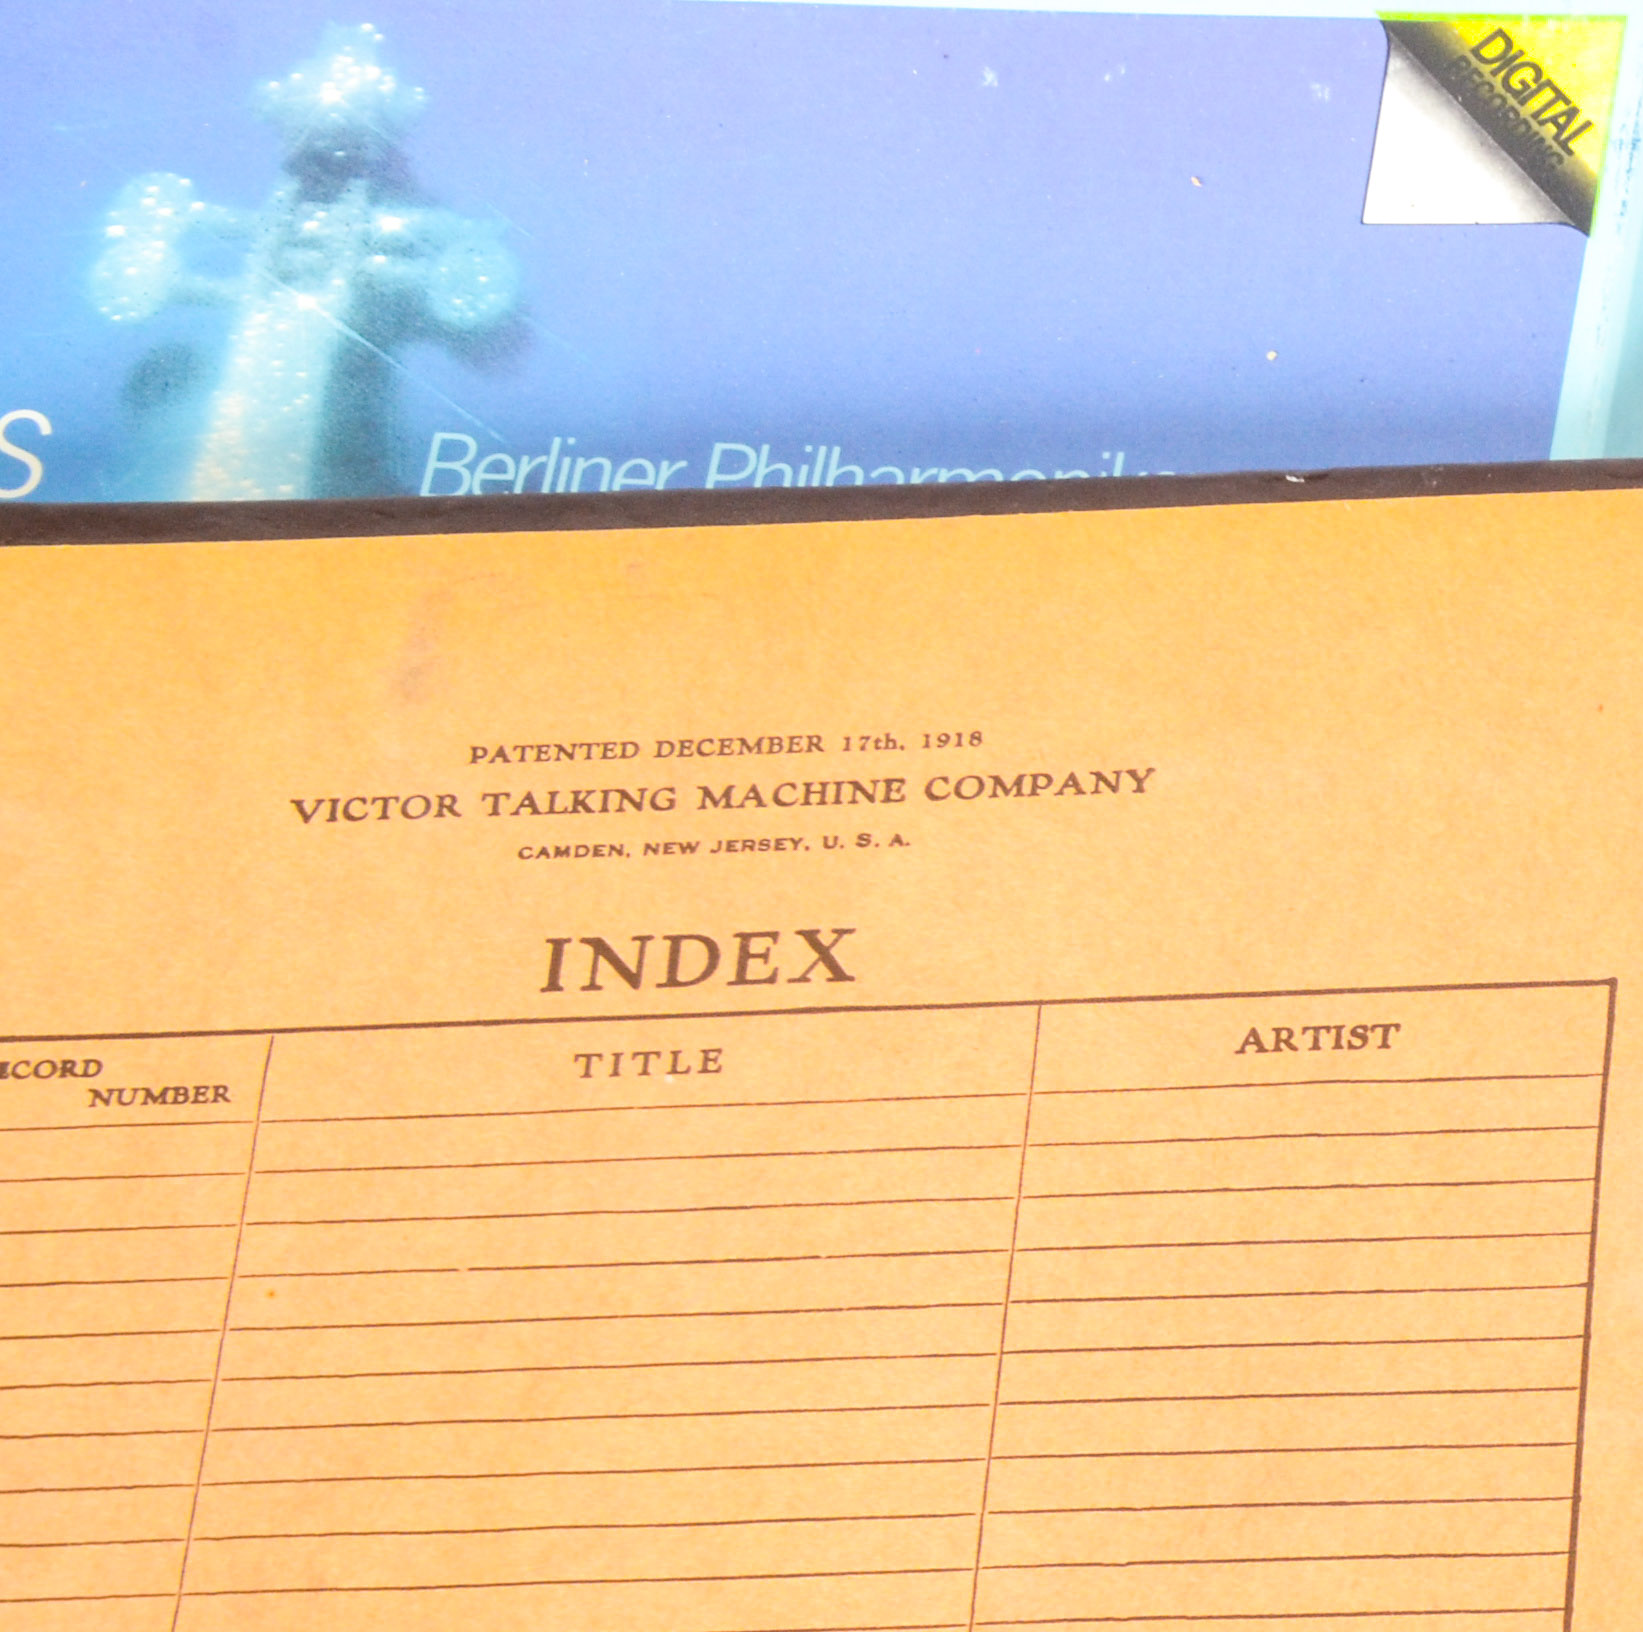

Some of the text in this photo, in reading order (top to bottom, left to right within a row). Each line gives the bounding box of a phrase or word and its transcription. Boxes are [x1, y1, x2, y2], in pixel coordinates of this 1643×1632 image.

[1449, 54, 1565, 171] RECORDING
[1469, 28, 1594, 157] DIGITAL
[420, 433, 688, 496] Berliner
[469, 739, 640, 766] PATENTED
[653, 734, 826, 760] DECEMBER
[921, 730, 983, 750] 1918
[290, 766, 1158, 825] VICTOR TALKING MACHINE COMPANY
[517, 831, 911, 861] CAMDEN, NEW JERSEY, U. S. A.
[539, 927, 858, 994] INDEX
[1235, 1023, 1401, 1054] ARTIST
[574, 1049, 724, 1078] TITLE
[88, 1085, 231, 1107] NUMBER
